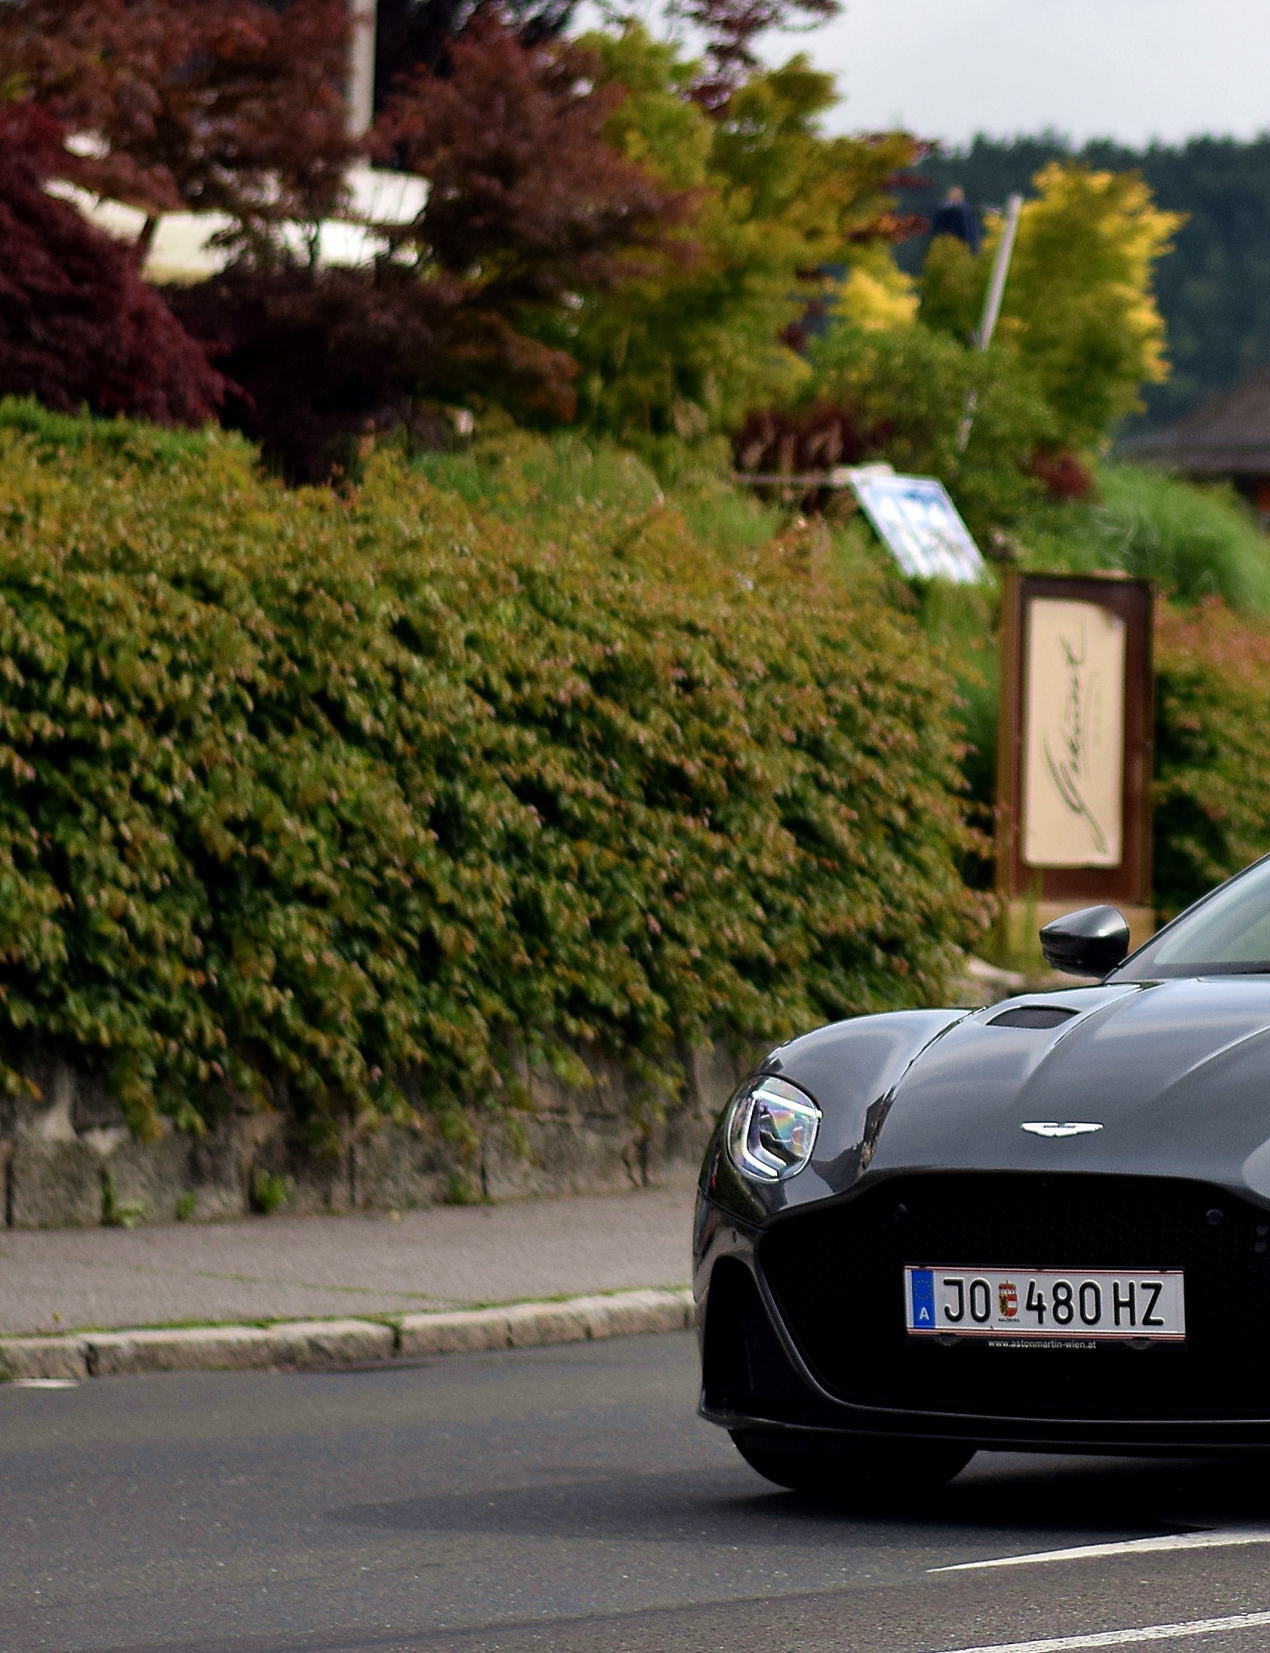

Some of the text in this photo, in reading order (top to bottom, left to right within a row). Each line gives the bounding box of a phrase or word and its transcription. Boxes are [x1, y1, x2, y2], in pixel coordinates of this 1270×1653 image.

[943, 1278, 1165, 1326] JO 480 HZ
[919, 1306, 930, 1320] A
[987, 1339, 1097, 1349] www.astonmartin-wien.at
